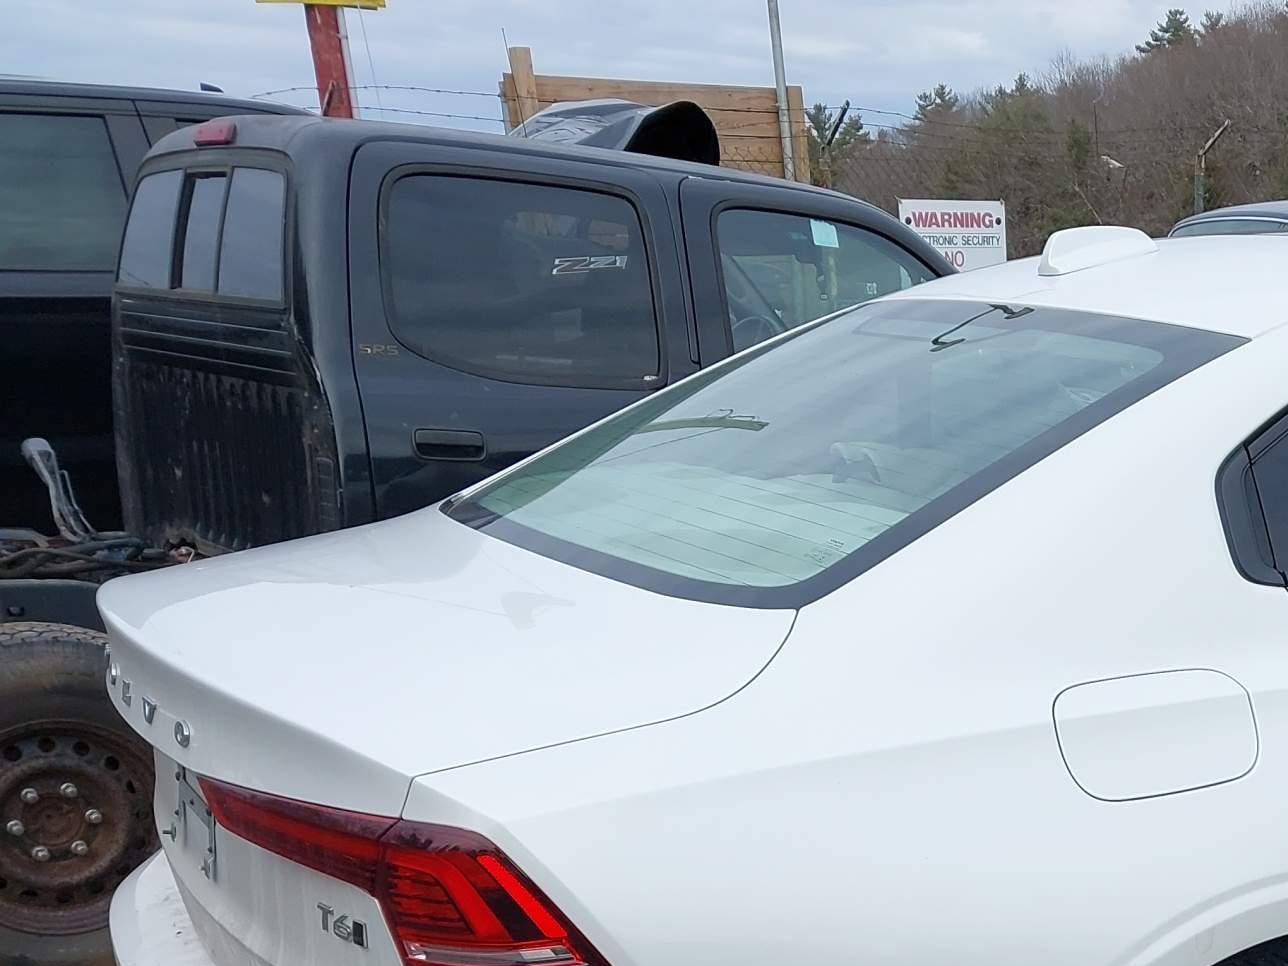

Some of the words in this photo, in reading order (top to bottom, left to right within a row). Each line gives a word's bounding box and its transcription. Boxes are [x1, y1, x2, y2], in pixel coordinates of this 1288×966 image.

[911, 211, 994, 229] WARNING
[962, 235, 1001, 246] SECURITY
[944, 251, 965, 267] NO
[317, 902, 353, 943] T6
